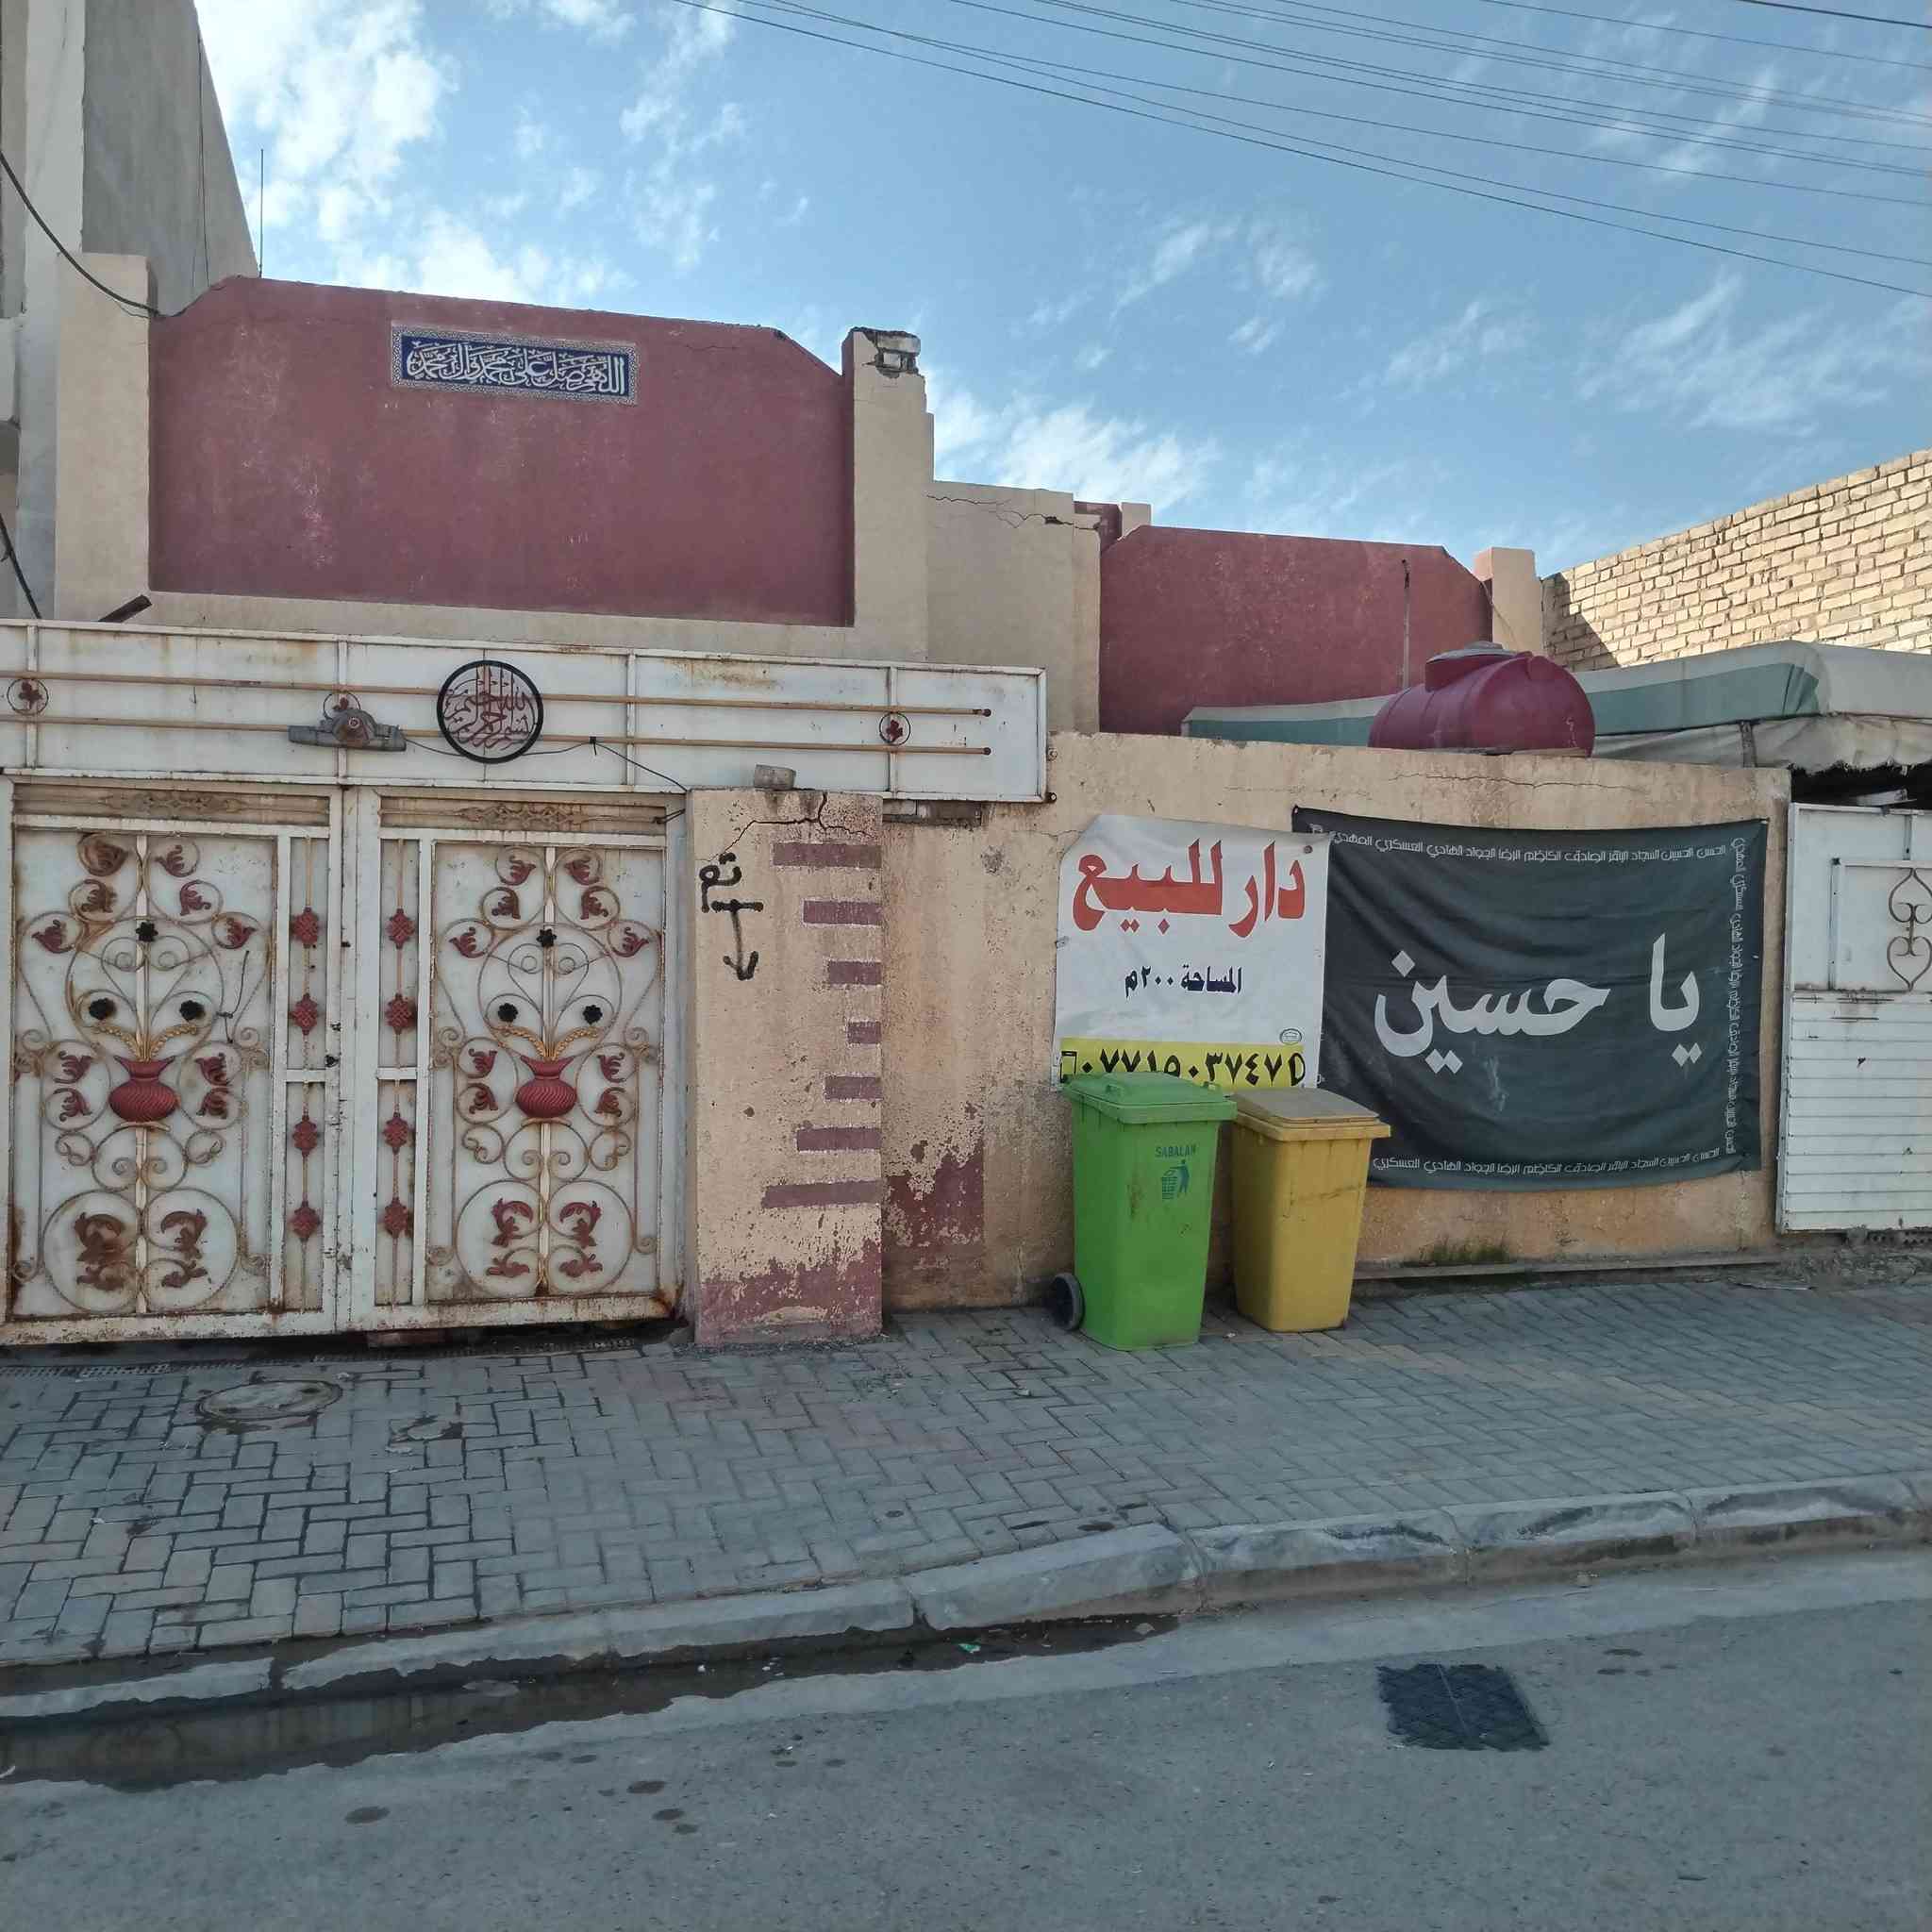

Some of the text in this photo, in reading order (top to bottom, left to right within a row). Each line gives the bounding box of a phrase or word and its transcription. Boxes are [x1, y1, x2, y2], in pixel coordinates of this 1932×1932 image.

[1073, 838, 1305, 938] دار للبيع
[1181, 963, 1241, 993] المساحة
[1374, 933, 1702, 1074] يا حسين
